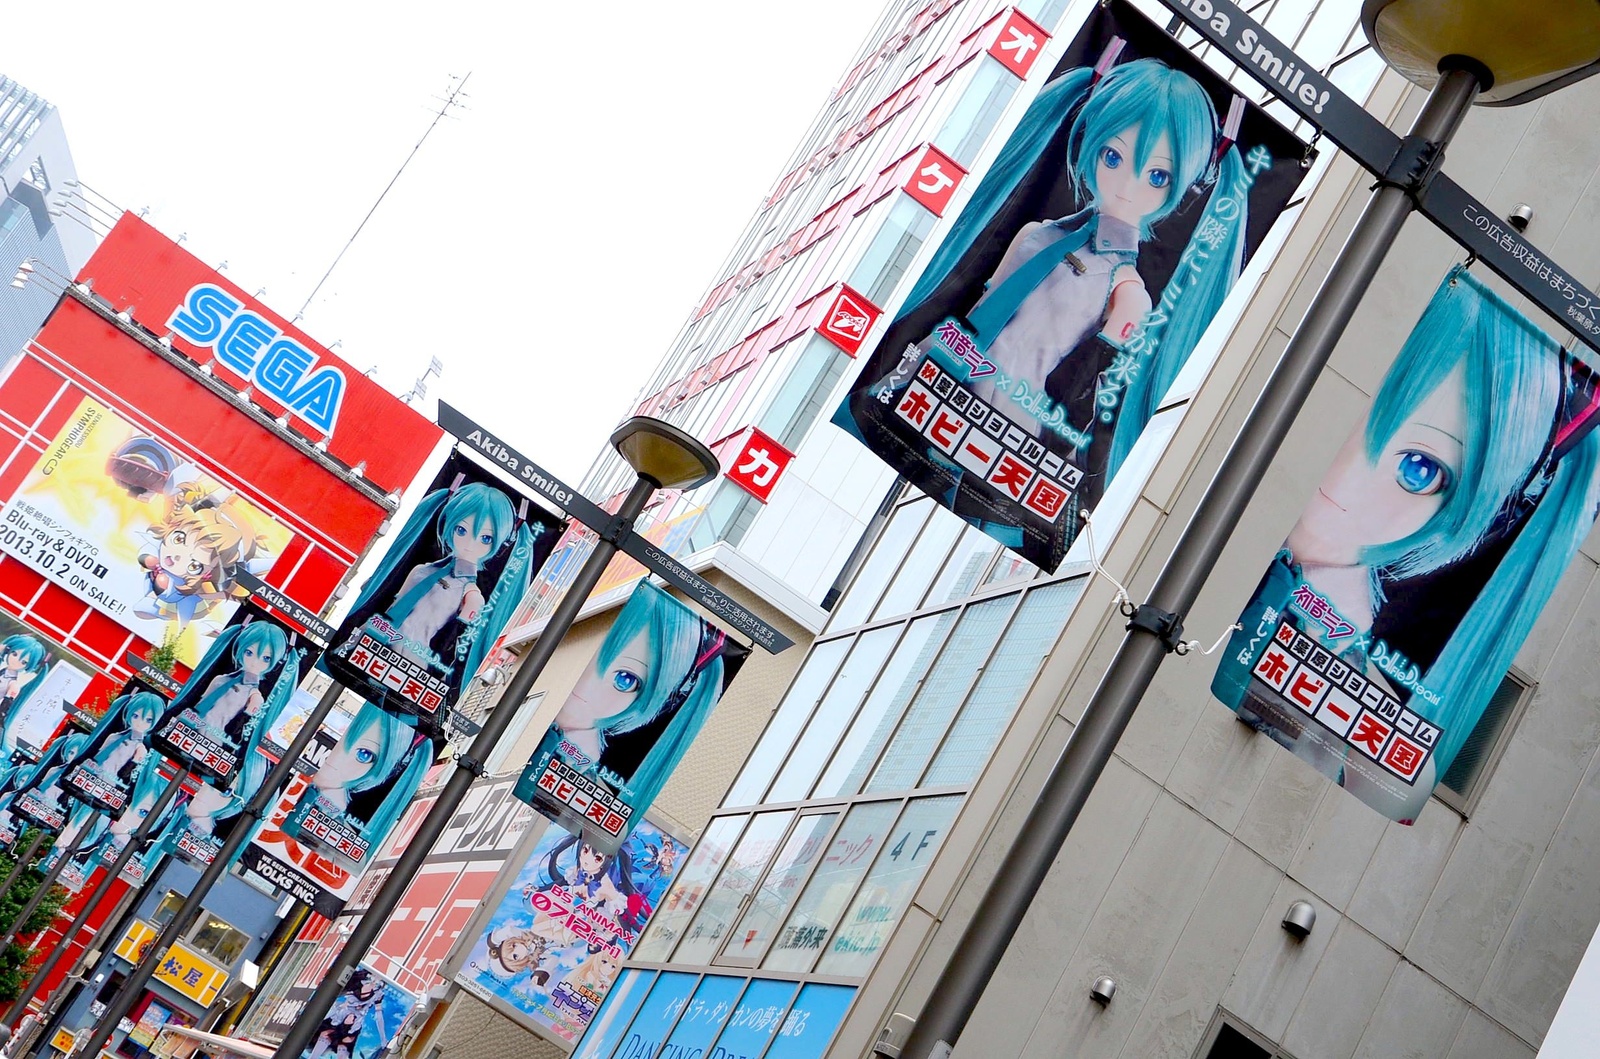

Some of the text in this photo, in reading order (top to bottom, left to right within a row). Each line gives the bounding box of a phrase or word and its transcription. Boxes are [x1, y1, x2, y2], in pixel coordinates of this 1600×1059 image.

[1001, 26, 1037, 64] オ
[1235, 28, 1331, 114] Smile!
[918, 162, 954, 197] ケ
[165, 283, 346, 437] SEGA
[876, 343, 921, 405] 詳しくは
[934, 321, 996, 378] 初音ミク
[55, 407, 96, 460] SYMPHOGEAR
[921, 362, 1081, 489] 秋葉原ショールーム
[466, 429, 573, 506] Akiba Smile!
[736, 447, 780, 487] カ
[900, 388, 1069, 516] ホビー天国
[69, 575, 88, 592] ON
[87, 586, 127, 616] SALE!!
[255, 584, 331, 637] Akiba Smile!
[1291, 584, 1356, 639] 初音ミク
[1236, 605, 1279, 666] 詳しくは
[140, 665, 170, 686] Akiba
[349, 648, 443, 711] ホビー天国
[1278, 623, 1434, 743] 秋葉原ショールーム
[74, 710, 98, 728] Akiba
[1258, 649, 1424, 777] ホビー天国
[27, 745, 44, 759] Akib
[168, 730, 232, 775] ホビー天国
[528, 751, 550, 784] 詳しくは
[558, 738, 592, 768] 初音ミク
[73, 774, 124, 809] ホビー天国
[539, 769, 626, 836] ホビー天国
[178, 836, 215, 864] ホビー天
[302, 817, 365, 862] ホビー天国
[255, 861, 291, 891] VOLKS
[291, 884, 315, 906] INC.
[261, 854, 273, 866] WE
[271, 859, 289, 875] SEEK
[286, 870, 320, 895] CREATIVITY
[550, 884, 574, 904] BS
[576, 904, 636, 944] ANIMAX
[163, 956, 203, 988] 松屋
